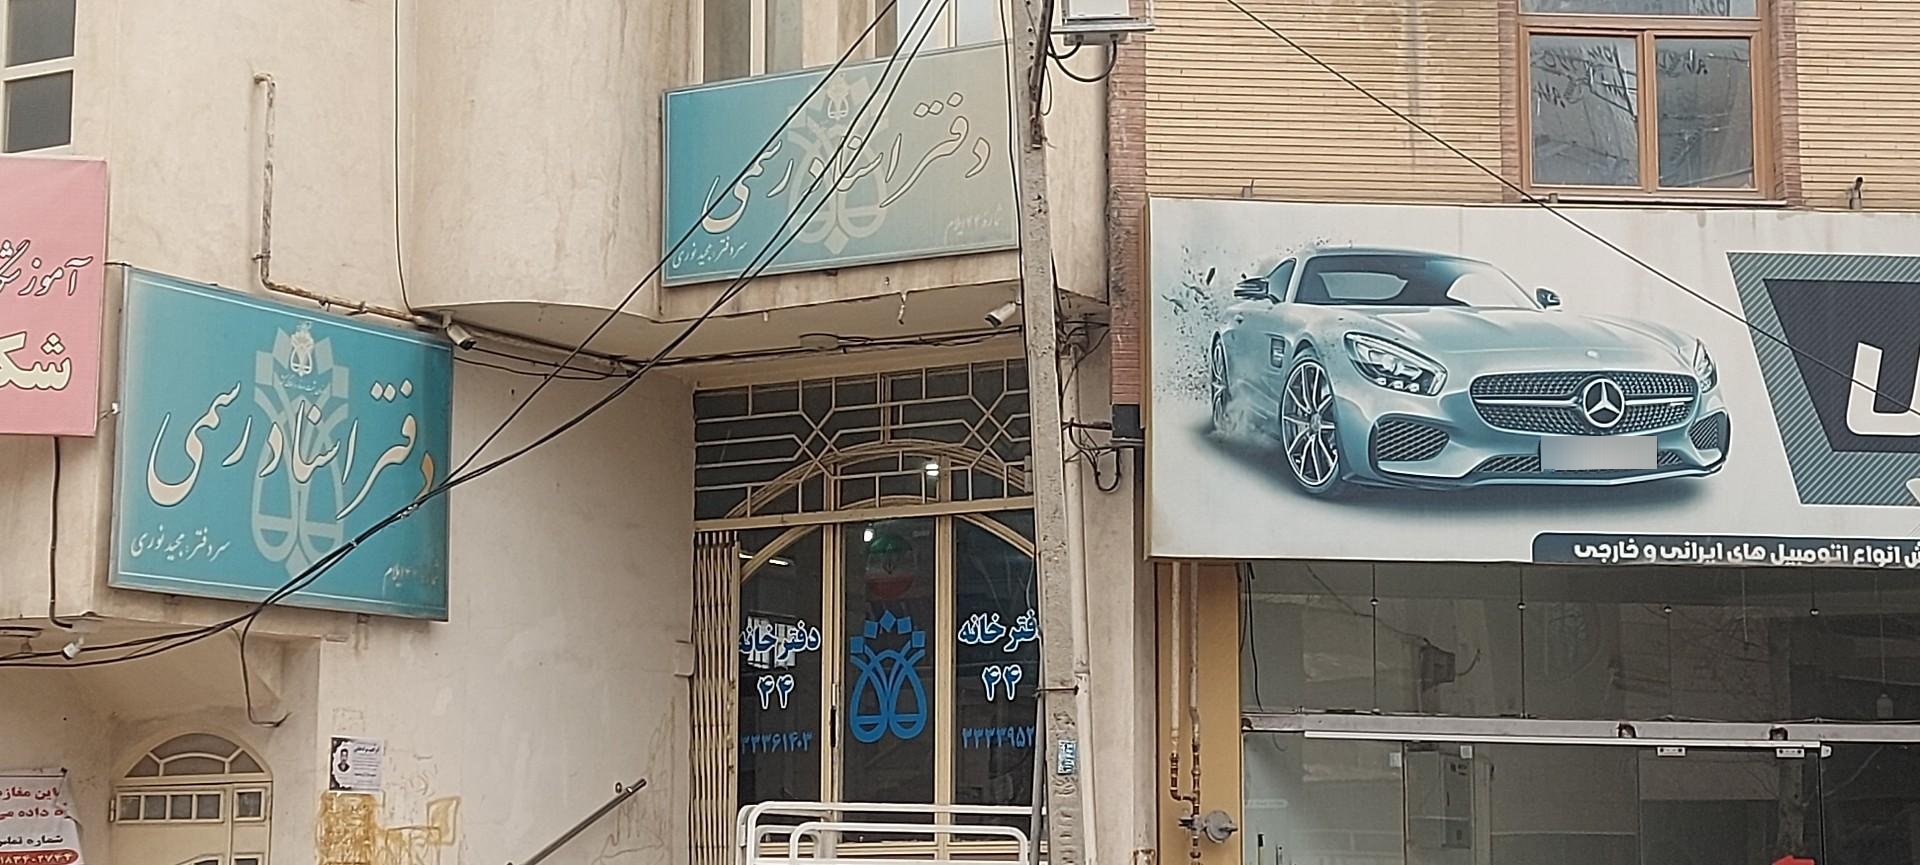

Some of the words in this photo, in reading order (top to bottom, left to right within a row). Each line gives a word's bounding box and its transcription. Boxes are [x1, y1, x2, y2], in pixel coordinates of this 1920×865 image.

[801, 131, 903, 196] اسناد
[878, 91, 992, 209] دفتر
[700, 139, 795, 235] رسمی
[0, 331, 72, 391] شک
[146, 381, 252, 507] رسمی
[257, 399, 359, 485] اسناد
[336, 378, 436, 520] دفتر
[130, 524, 166, 557] نوری
[1573, 538, 1640, 564] خارجی
[1643, 544, 1656, 564] و
[1660, 541, 1723, 564] ایرانی
[1726, 543, 1766, 563] های
[1769, 543, 1849, 566] اتومبیل
[1852, 544, 1900, 567] انواع
[757, 674, 795, 709] ۴۴
[981, 664, 1022, 701] ۴۴
